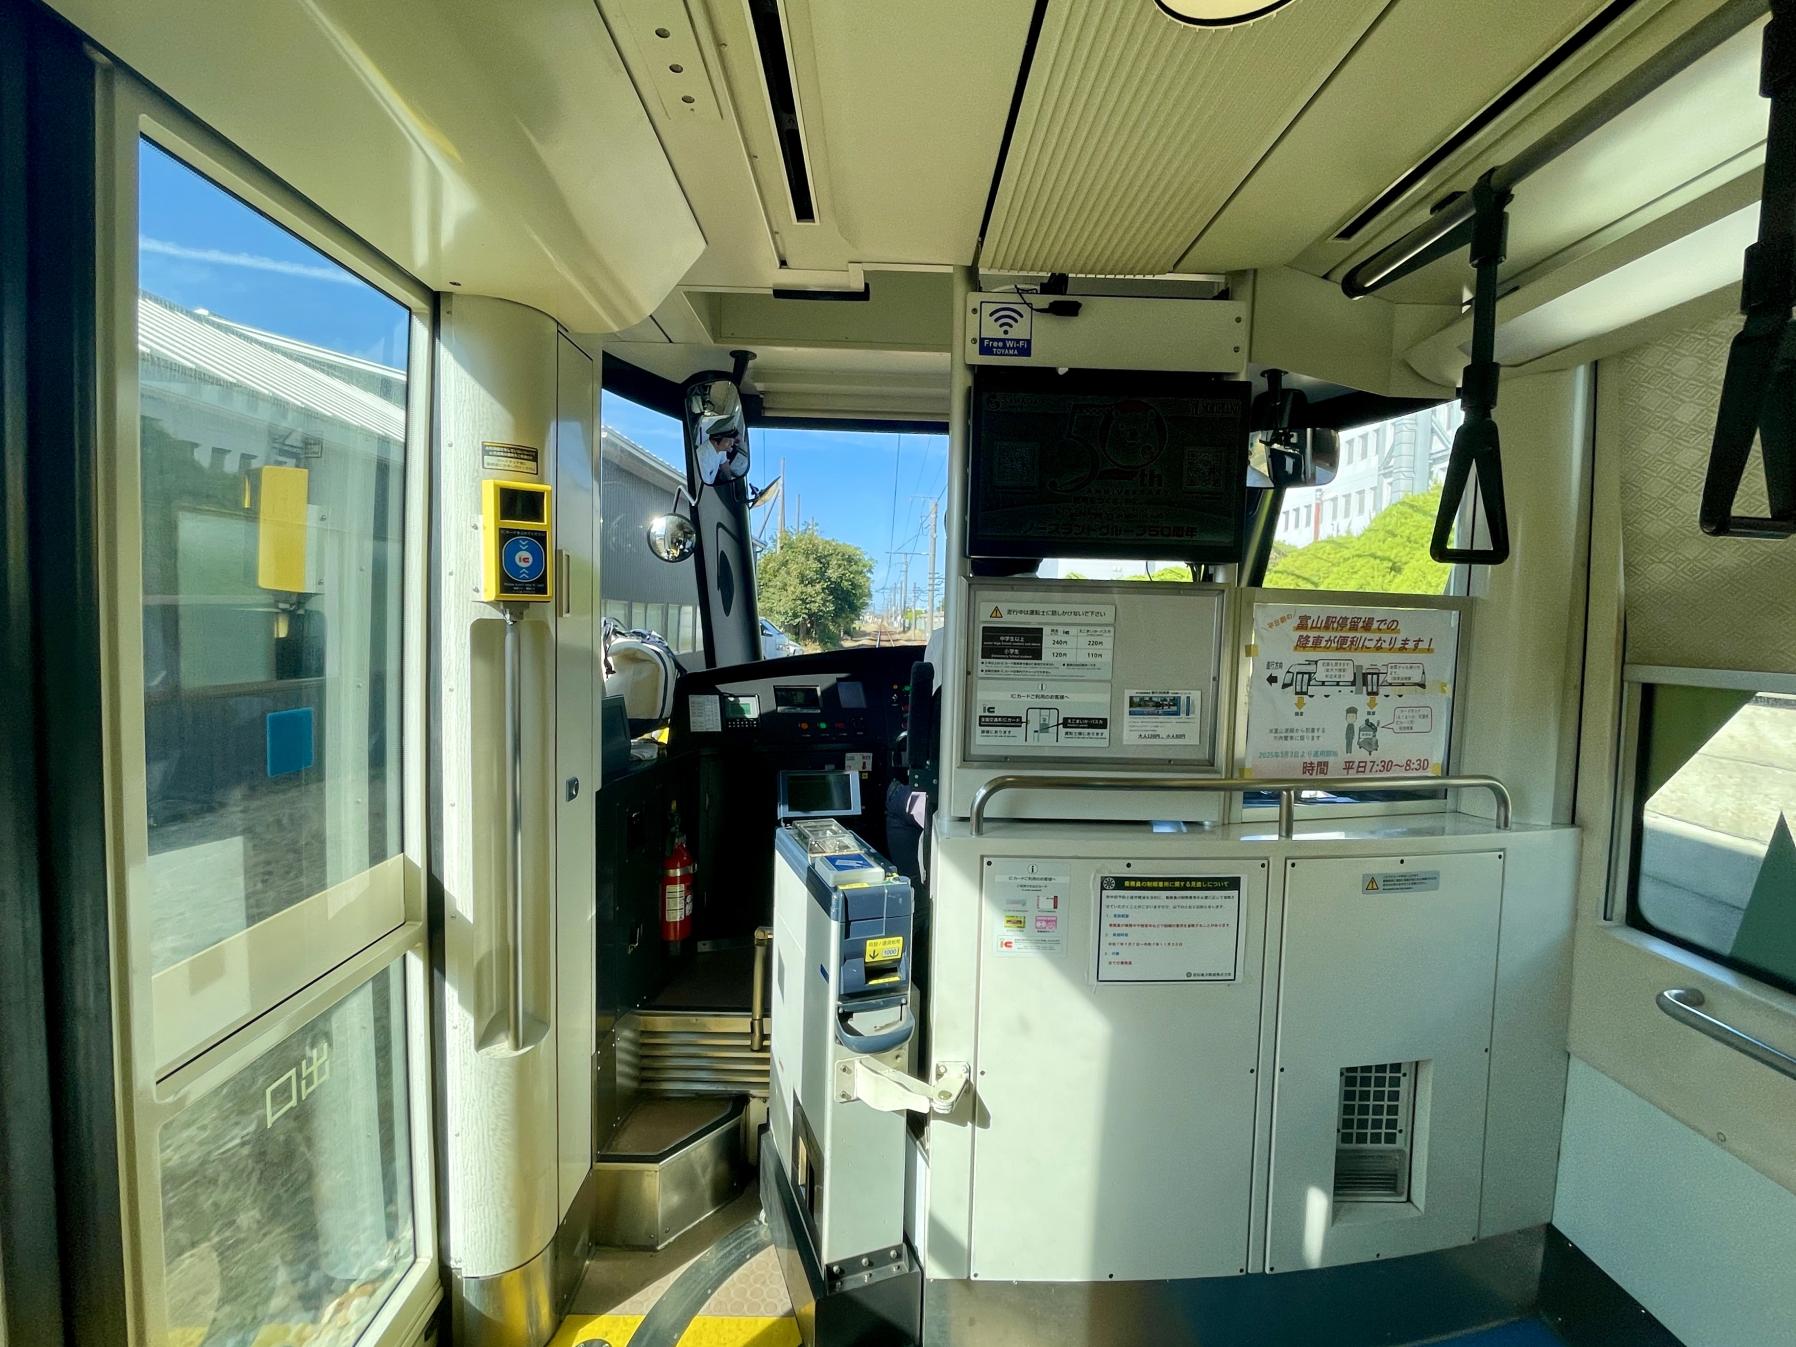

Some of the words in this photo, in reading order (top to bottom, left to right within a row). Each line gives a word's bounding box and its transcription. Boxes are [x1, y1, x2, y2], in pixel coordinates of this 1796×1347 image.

[984, 340, 1004, 348] Free
[1005, 340, 1027, 348] Wi-Fi
[1295, 615, 1399, 632] 富山駅停留場での
[1302, 761, 1329, 776] 時間
